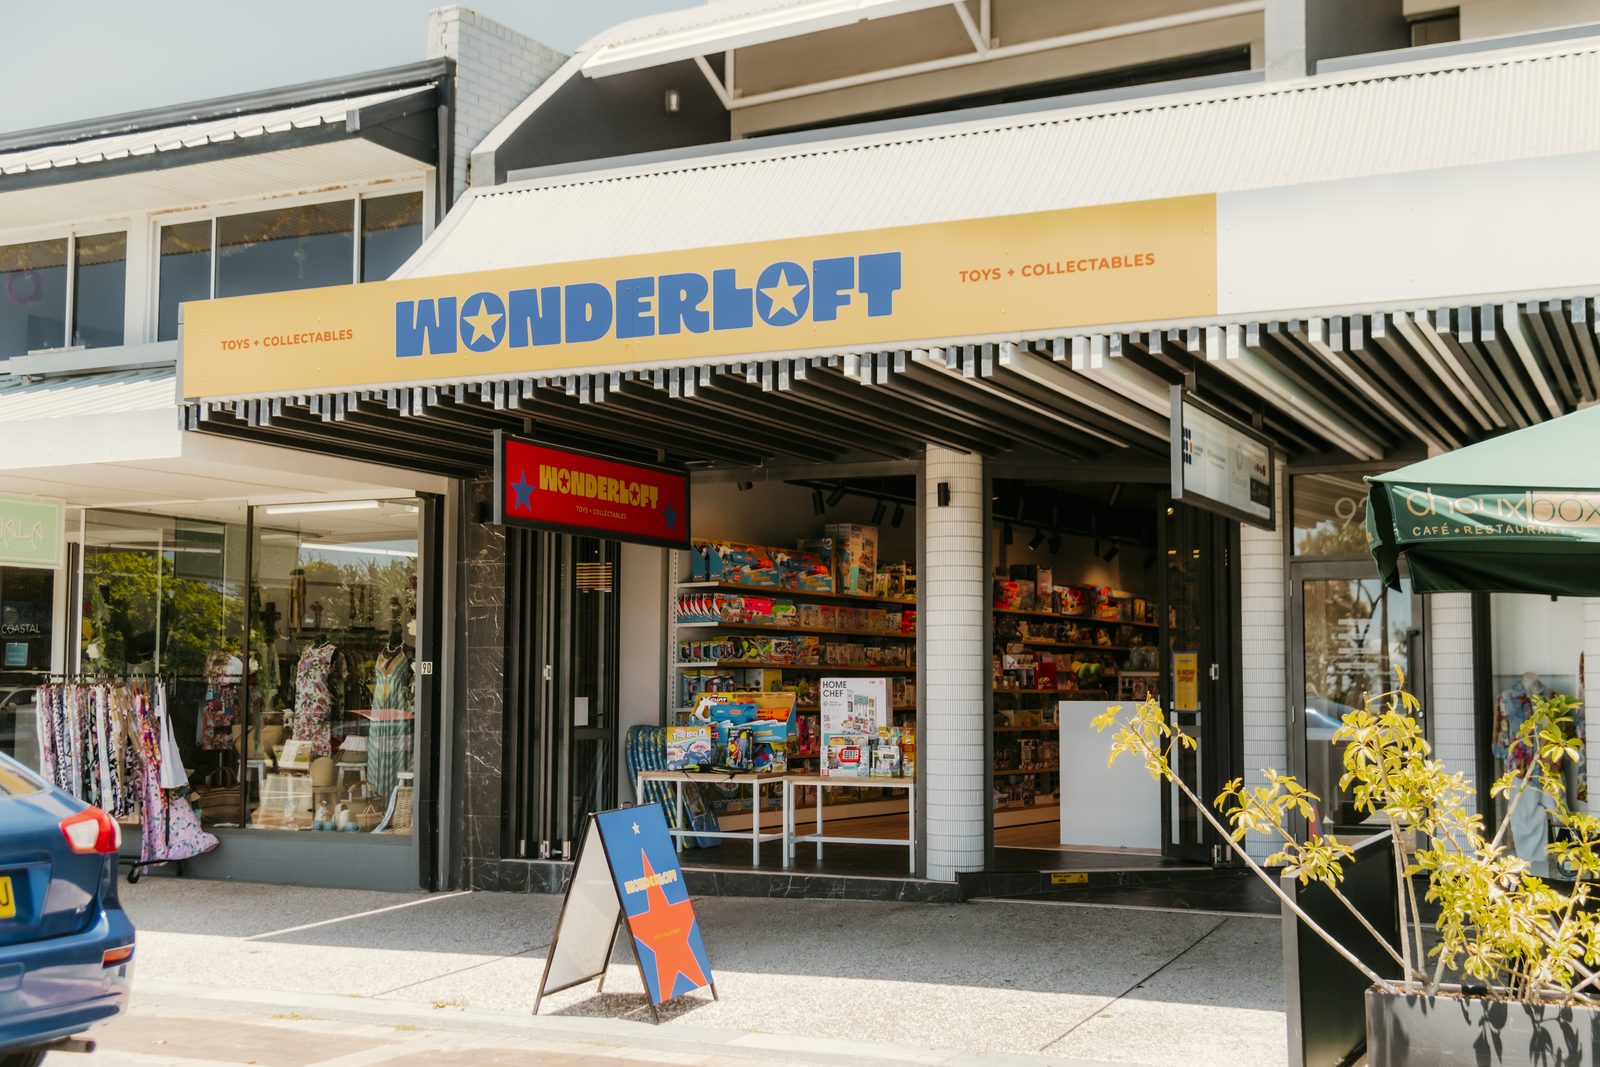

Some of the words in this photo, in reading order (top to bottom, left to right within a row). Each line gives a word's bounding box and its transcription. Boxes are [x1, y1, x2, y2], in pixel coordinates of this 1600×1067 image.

[959, 268, 1001, 283] TOYS
[1021, 253, 1155, 277] COLLECTABLES
[395, 251, 902, 358] WONDERLOFT
[221, 339, 250, 350] TOYS
[263, 329, 353, 347] COLLECTABLES
[539, 464, 659, 509] WONDERLOFT
[576, 505, 588, 513] TOYS
[593, 508, 627, 519] COLLECTABLES
[1412, 523, 1450, 537] CAFÉ
[1, 623, 41, 634] COASTAL
[422, 662, 432, 674] 90
[823, 680, 847, 689] HOME
[823, 689, 844, 698] CHEF
